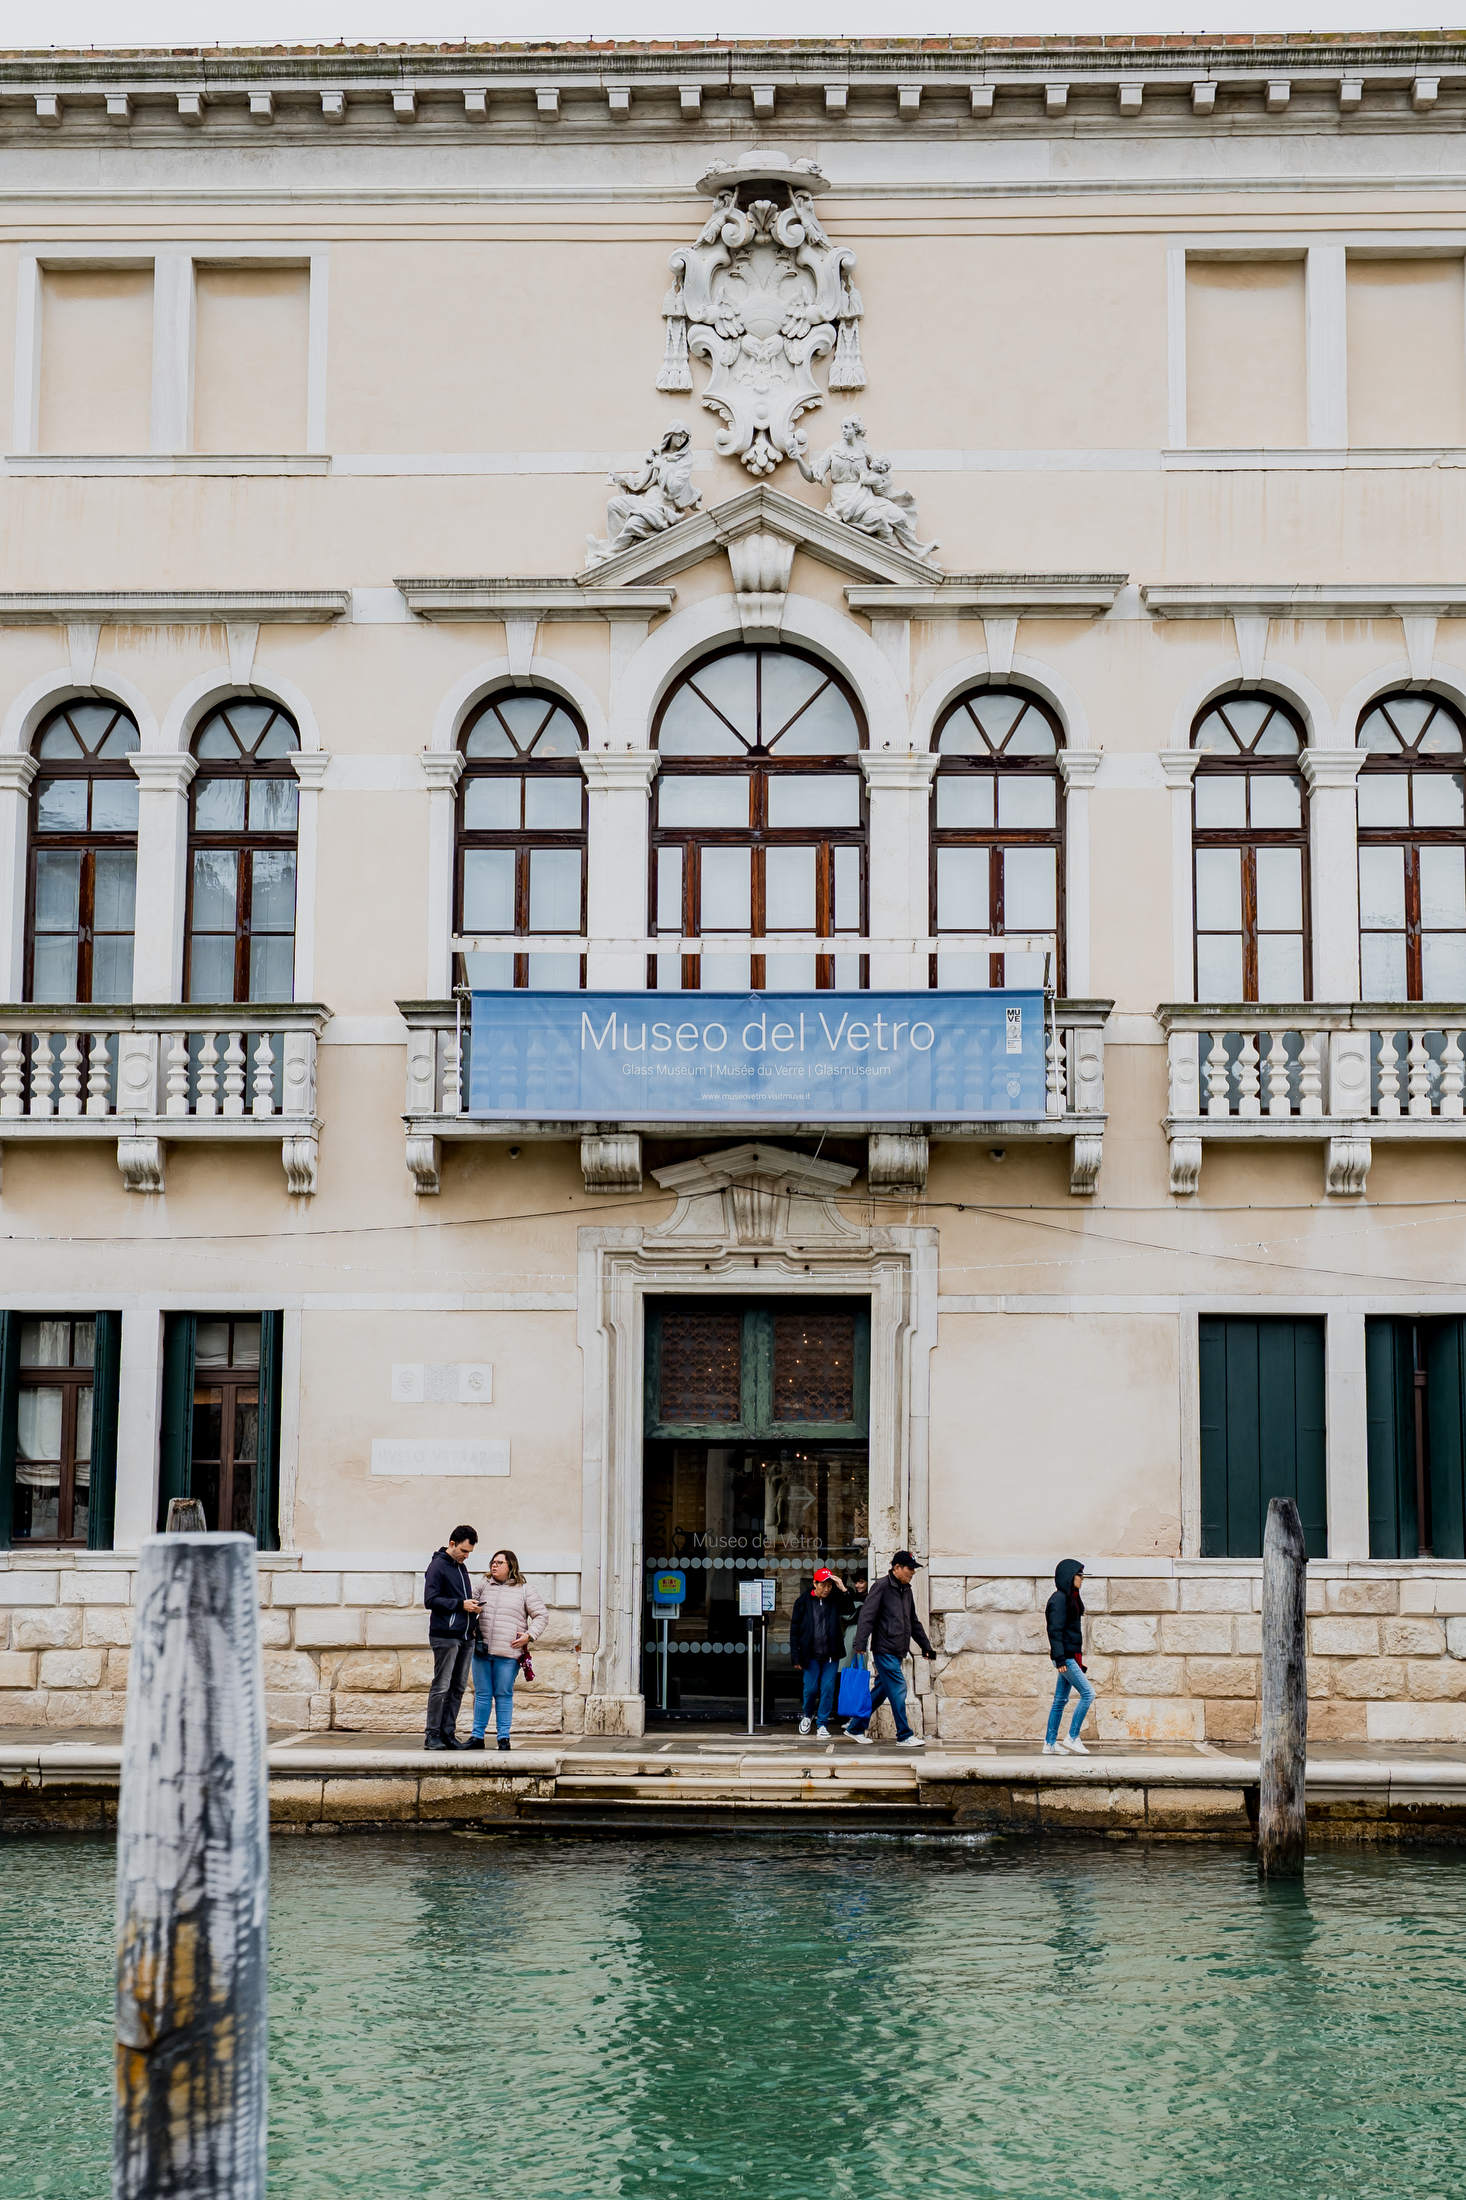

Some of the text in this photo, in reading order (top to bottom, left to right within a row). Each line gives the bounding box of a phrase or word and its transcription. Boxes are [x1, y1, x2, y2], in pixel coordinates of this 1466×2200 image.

[581, 1011, 935, 1051] Museo del Vetro
[622, 1063, 891, 1077] Glass Museum Musée du Verre Glasmuseum
[693, 1532, 823, 1549] Museo del Vetro
